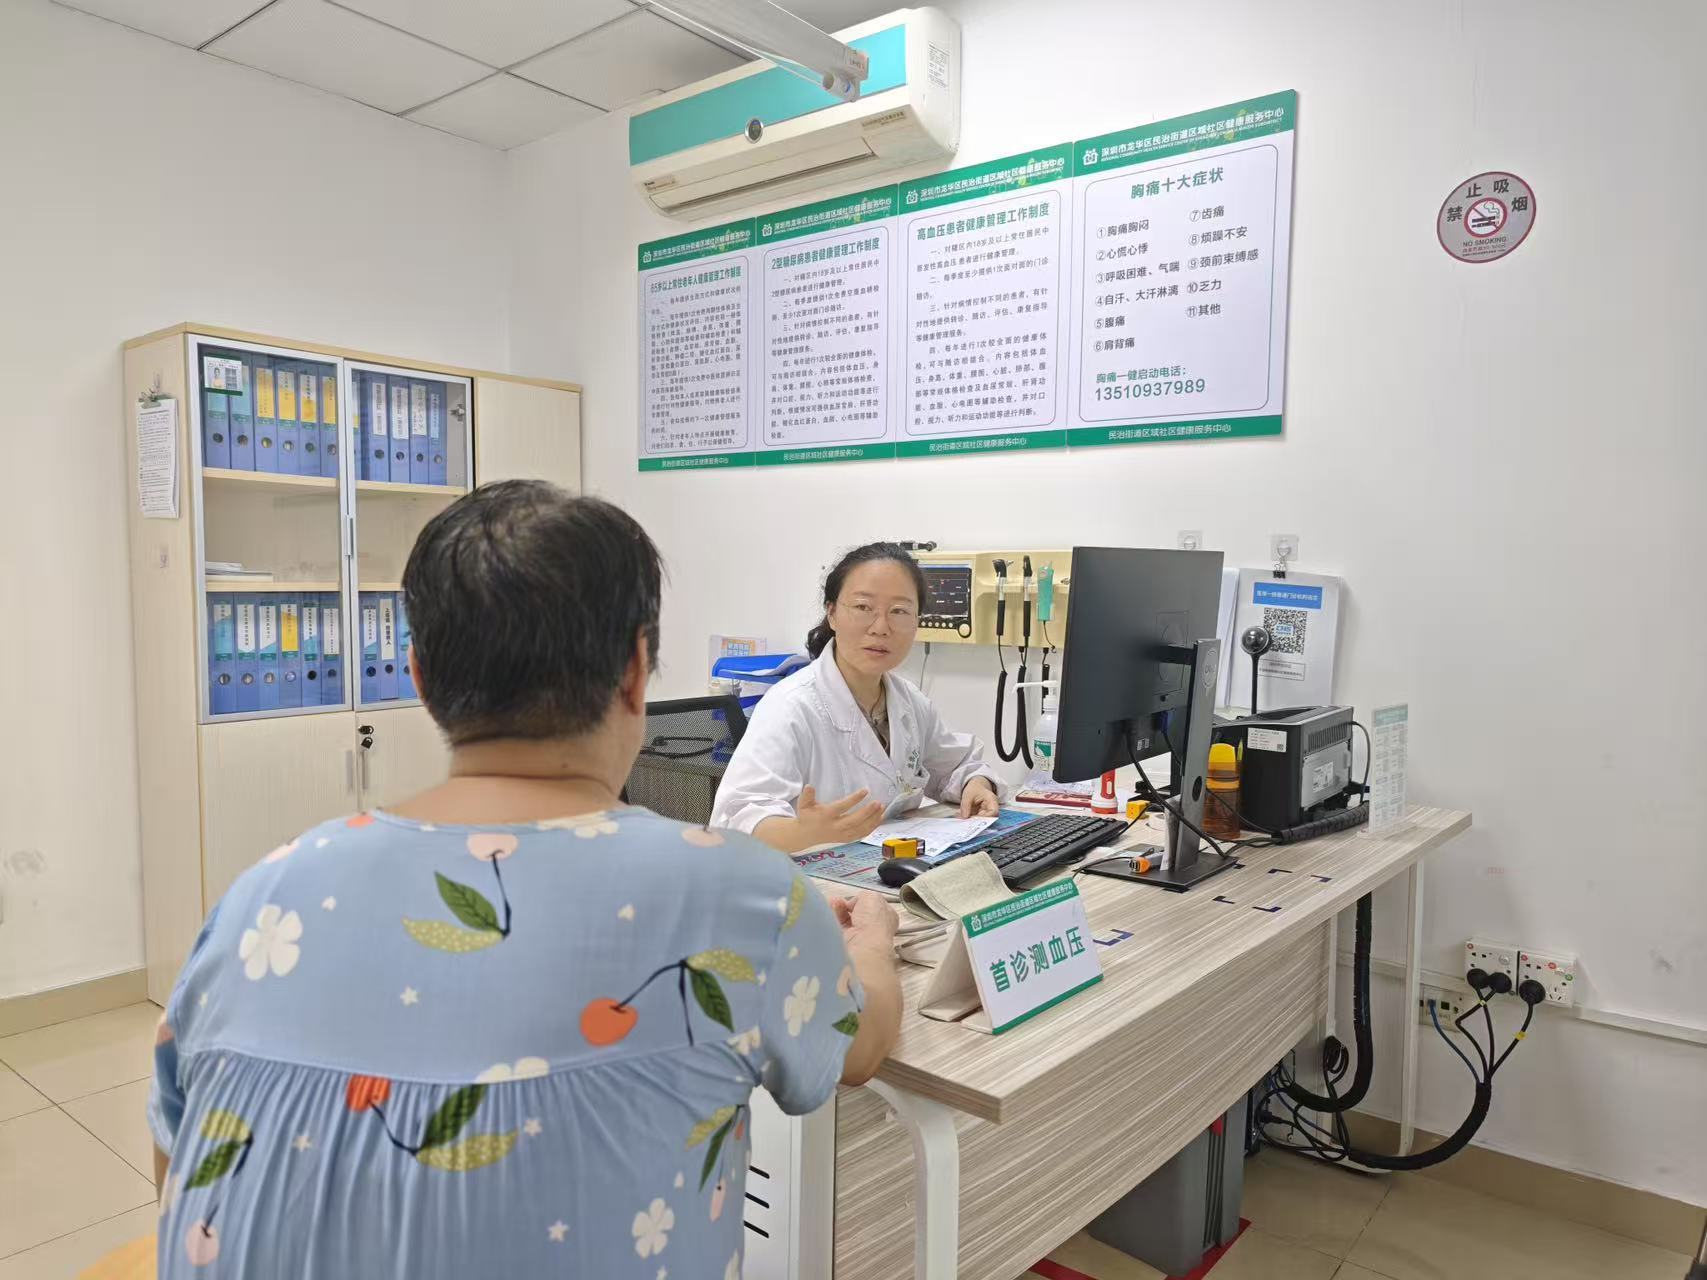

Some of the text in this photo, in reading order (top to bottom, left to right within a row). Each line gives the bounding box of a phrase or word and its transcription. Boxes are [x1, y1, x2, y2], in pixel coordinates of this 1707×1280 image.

[1101, 107, 1284, 158] 深圳市龙华区民治街道区域社区健康服务中心
[1130, 165, 1224, 200] 胸痛十大症状
[917, 201, 1049, 241] 高血压患者健康管理工作制度
[771, 236, 879, 270] 2型糖尿病患者健康管理工作制度
[1474, 236, 1507, 246] SMOKING
[1094, 376, 1205, 403] 13510937989
[928, 436, 1027, 452] 民治街道区域社区健康服务中心
[1108, 424, 1232, 440] 民治街道区域社区健康服务中心
[989, 926, 1086, 993] 首诊测血压
